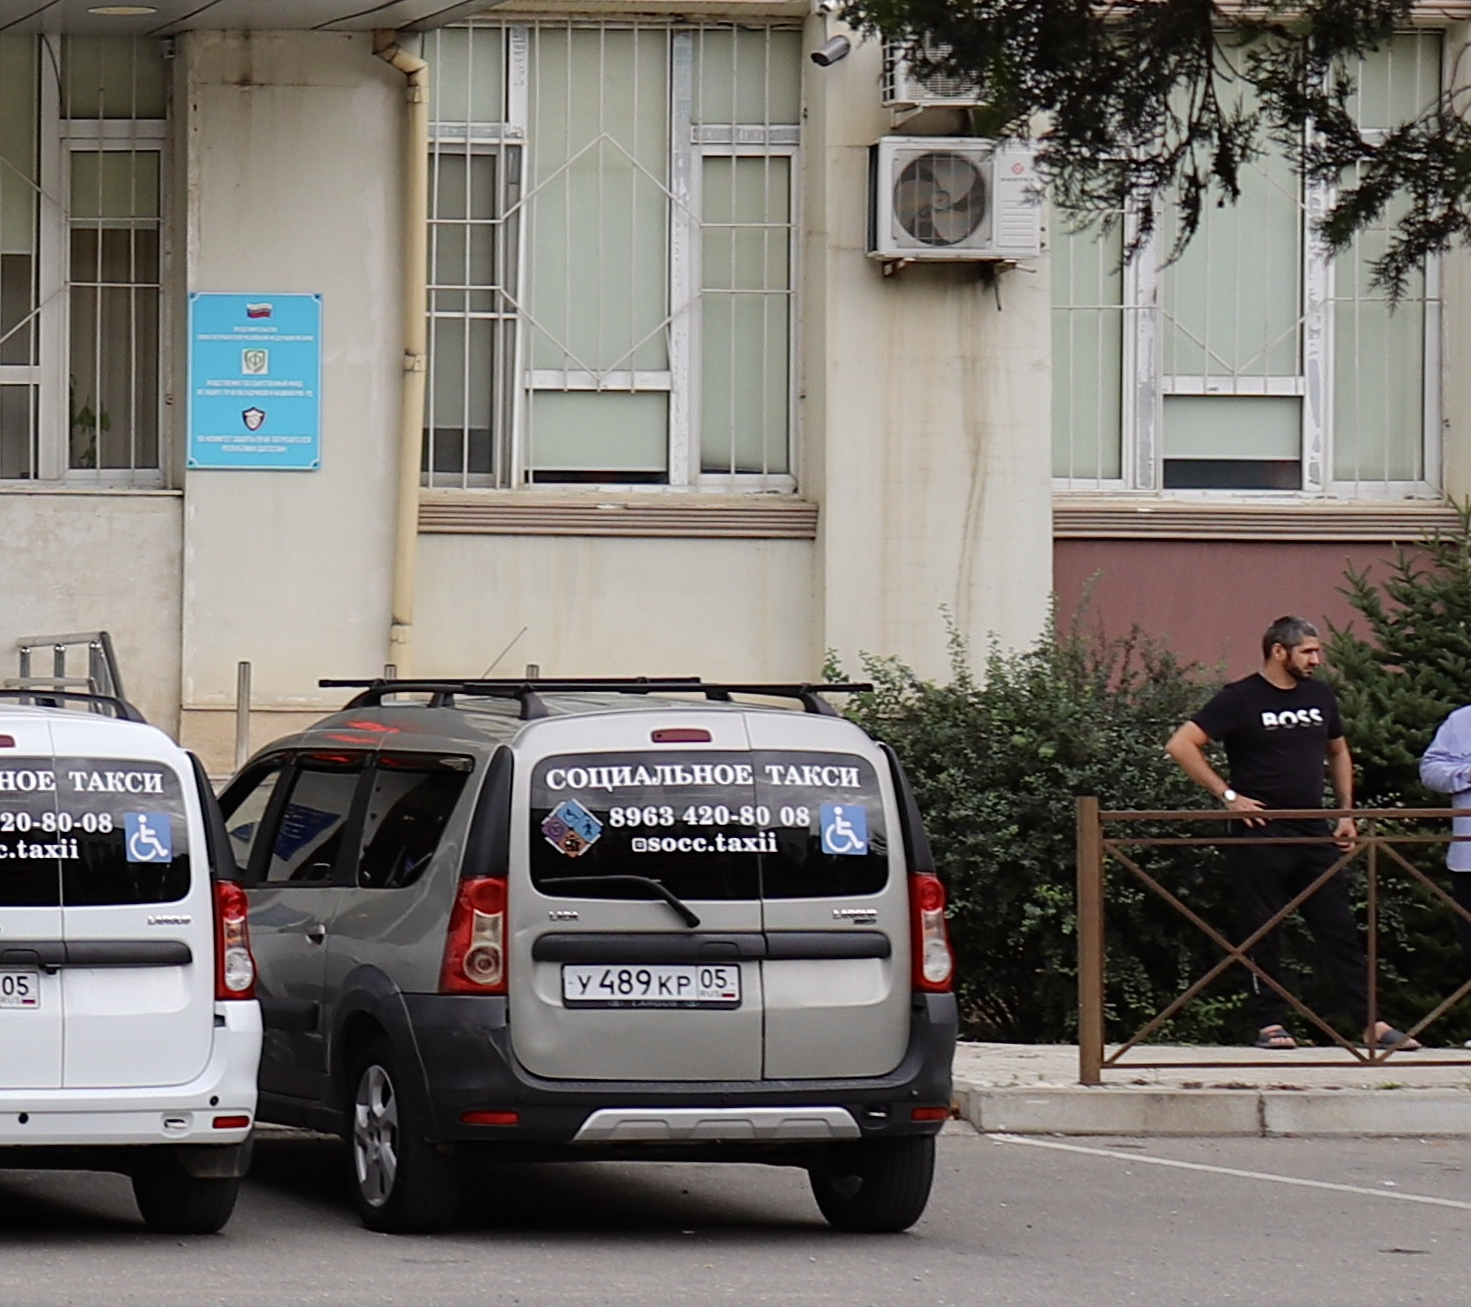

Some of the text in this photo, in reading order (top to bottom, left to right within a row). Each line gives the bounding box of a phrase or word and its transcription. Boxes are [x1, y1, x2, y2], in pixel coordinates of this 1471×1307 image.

[1261, 708, 1325, 730] BOSS
[68, 770, 164, 794] ТАКСИ
[546, 763, 861, 792] СОЦИАЛЬНОЕ ТАКСИ
[609, 805, 675, 827] 8963
[1, 975, 30, 997] 05
[700, 968, 728, 990] 05
